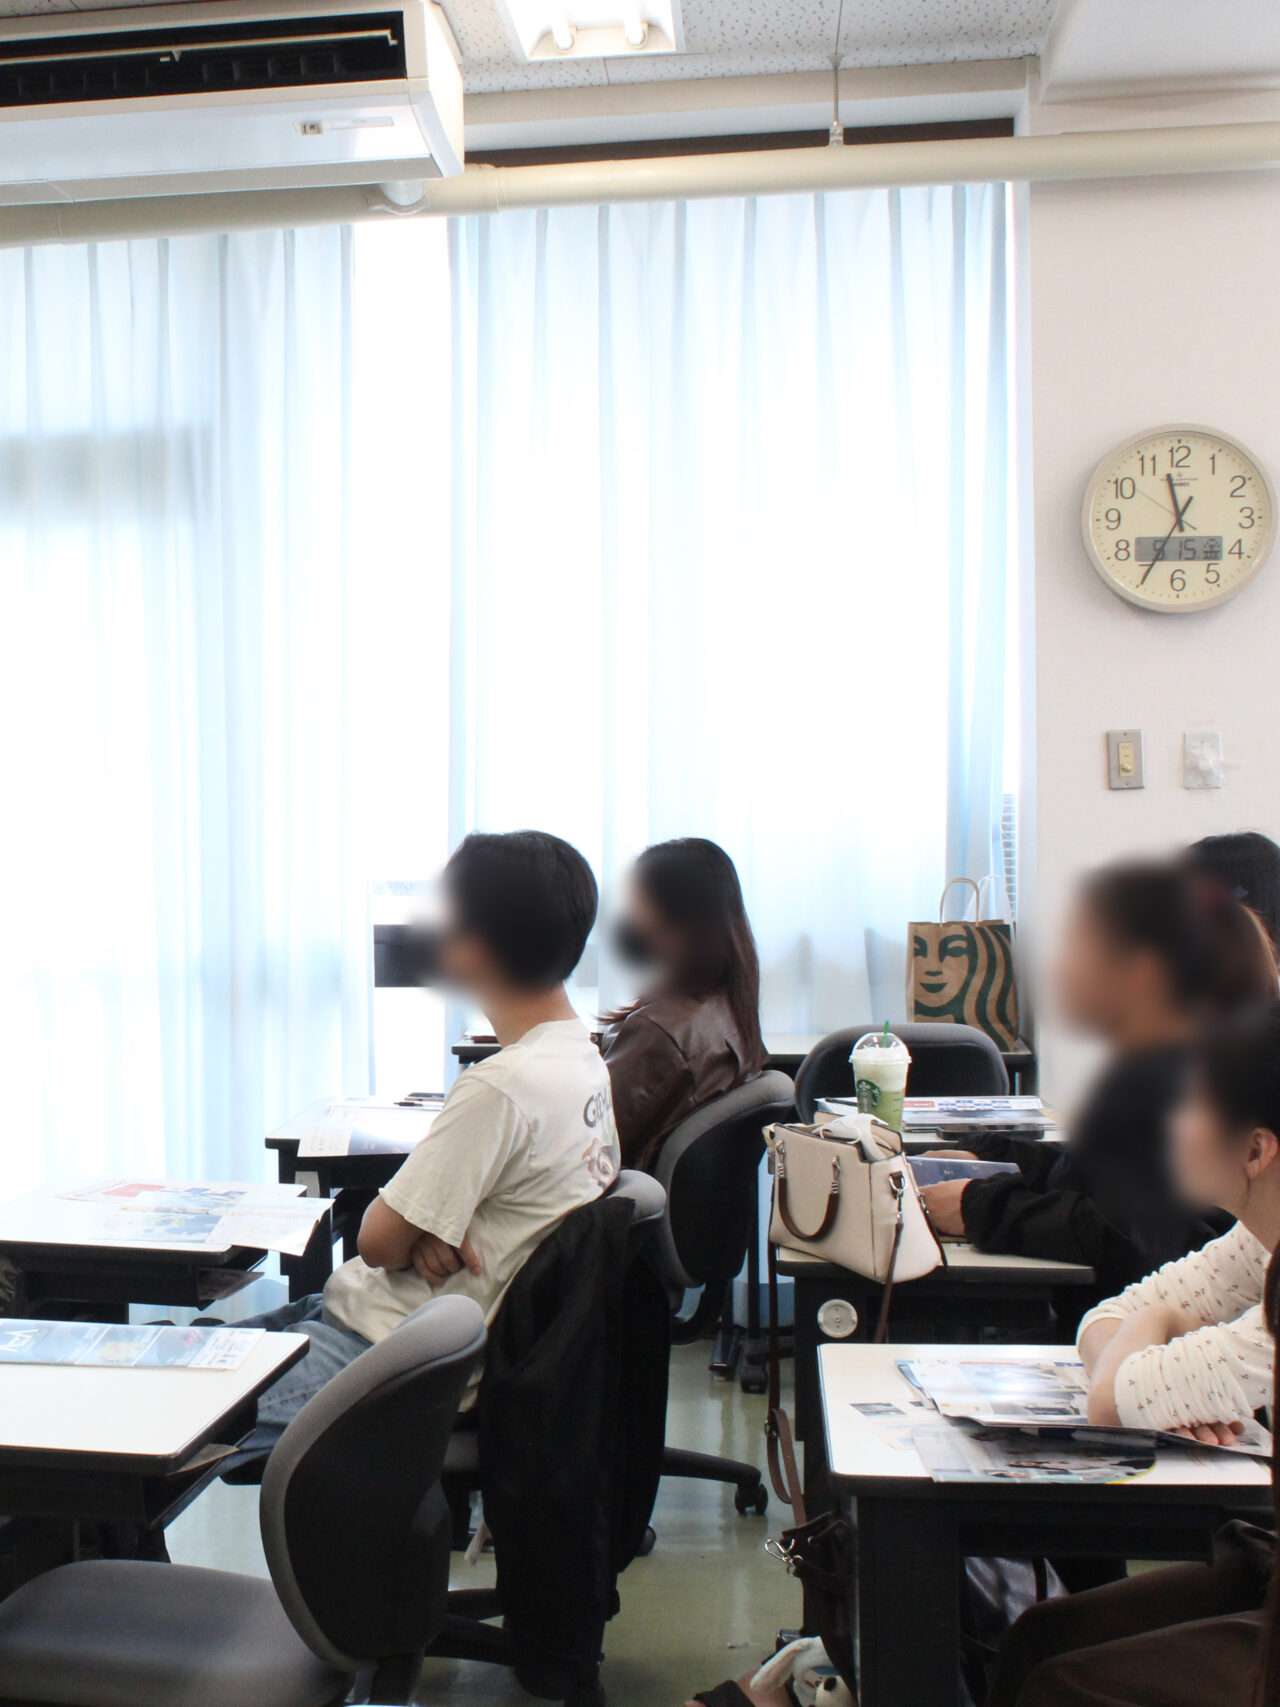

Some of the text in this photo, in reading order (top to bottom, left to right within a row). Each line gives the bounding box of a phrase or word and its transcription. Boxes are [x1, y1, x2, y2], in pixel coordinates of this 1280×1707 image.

[1138, 454, 1157, 477] 11
[1168, 445, 1192, 468] 12
[1208, 453, 1217, 476] 1
[1114, 477, 1136, 500] 10
[1229, 475, 1247, 498] 2
[1105, 507, 1122, 531] 9
[1238, 506, 1255, 529] 3
[1114, 539, 1131, 561] 8
[1178, 539, 1197, 561] 15
[1227, 538, 1245, 560] 4
[1170, 569, 1187, 592] 6
[1204, 562, 1221, 584] 5
